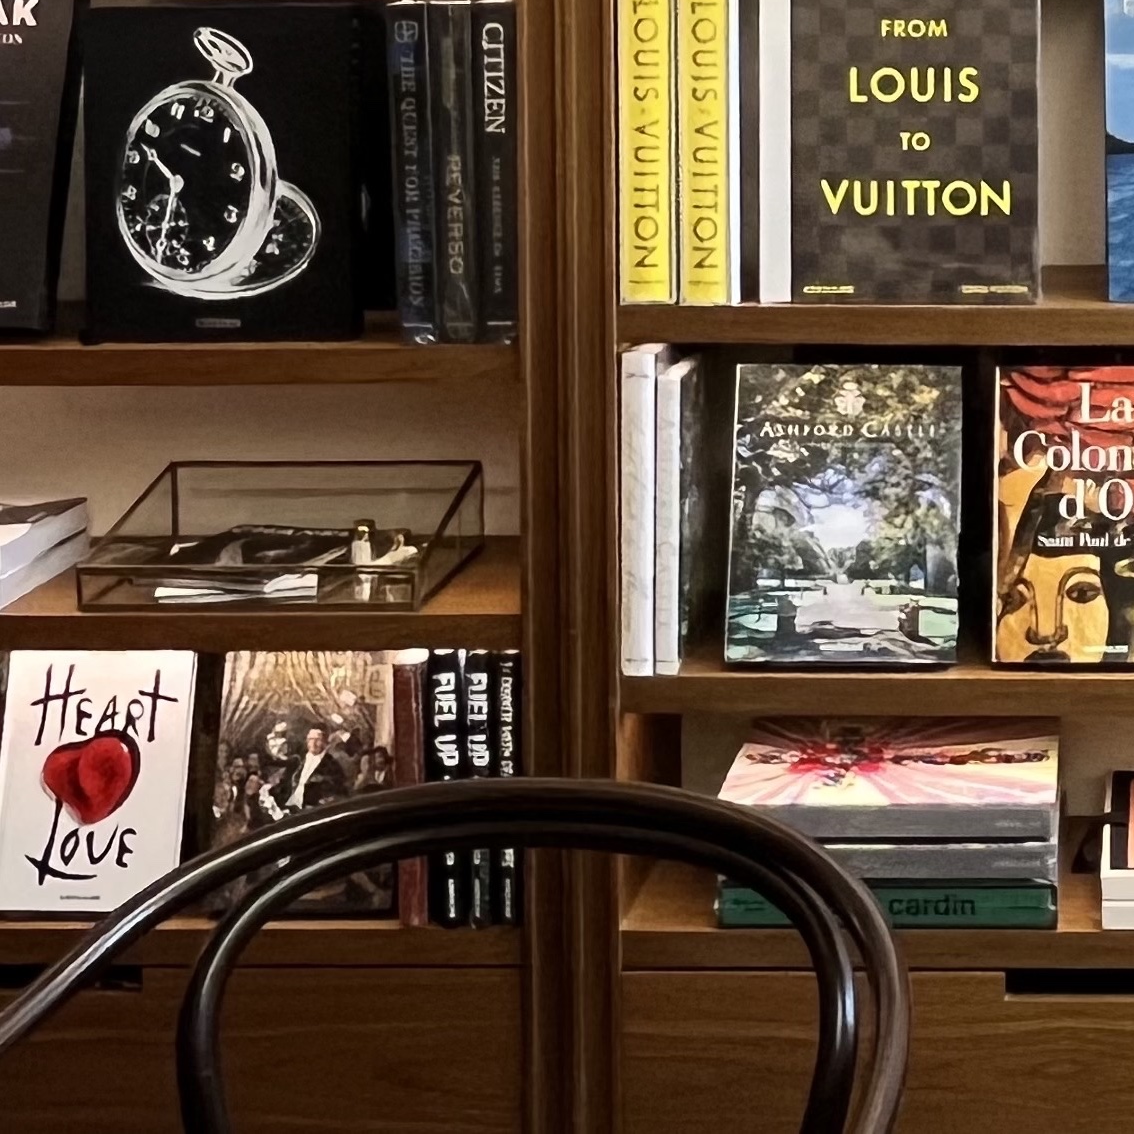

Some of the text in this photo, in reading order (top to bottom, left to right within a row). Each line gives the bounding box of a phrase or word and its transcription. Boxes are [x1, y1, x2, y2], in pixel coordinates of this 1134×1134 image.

[881, 20, 947, 38] FROM
[482, 22, 505, 134] CITIZEN
[849, 67, 980, 103] LOUIS
[632, 0, 660, 269] LOUIS VUITTON
[691, 1, 719, 269] LOUIS VUITTON
[900, 131, 930, 151] TO
[446, 154, 464, 275] REVERSO
[821, 180, 1012, 216] VUITTON
[760, 422, 854, 438] ASHFORD
[1079, 382, 1134, 423] La
[31, 664, 178, 745] HEART
[433, 672, 459, 766] FUEL UP
[465, 672, 489, 766] FUEL UP
[25, 799, 137, 885] LOVE
[888, 895, 976, 916] cardin
